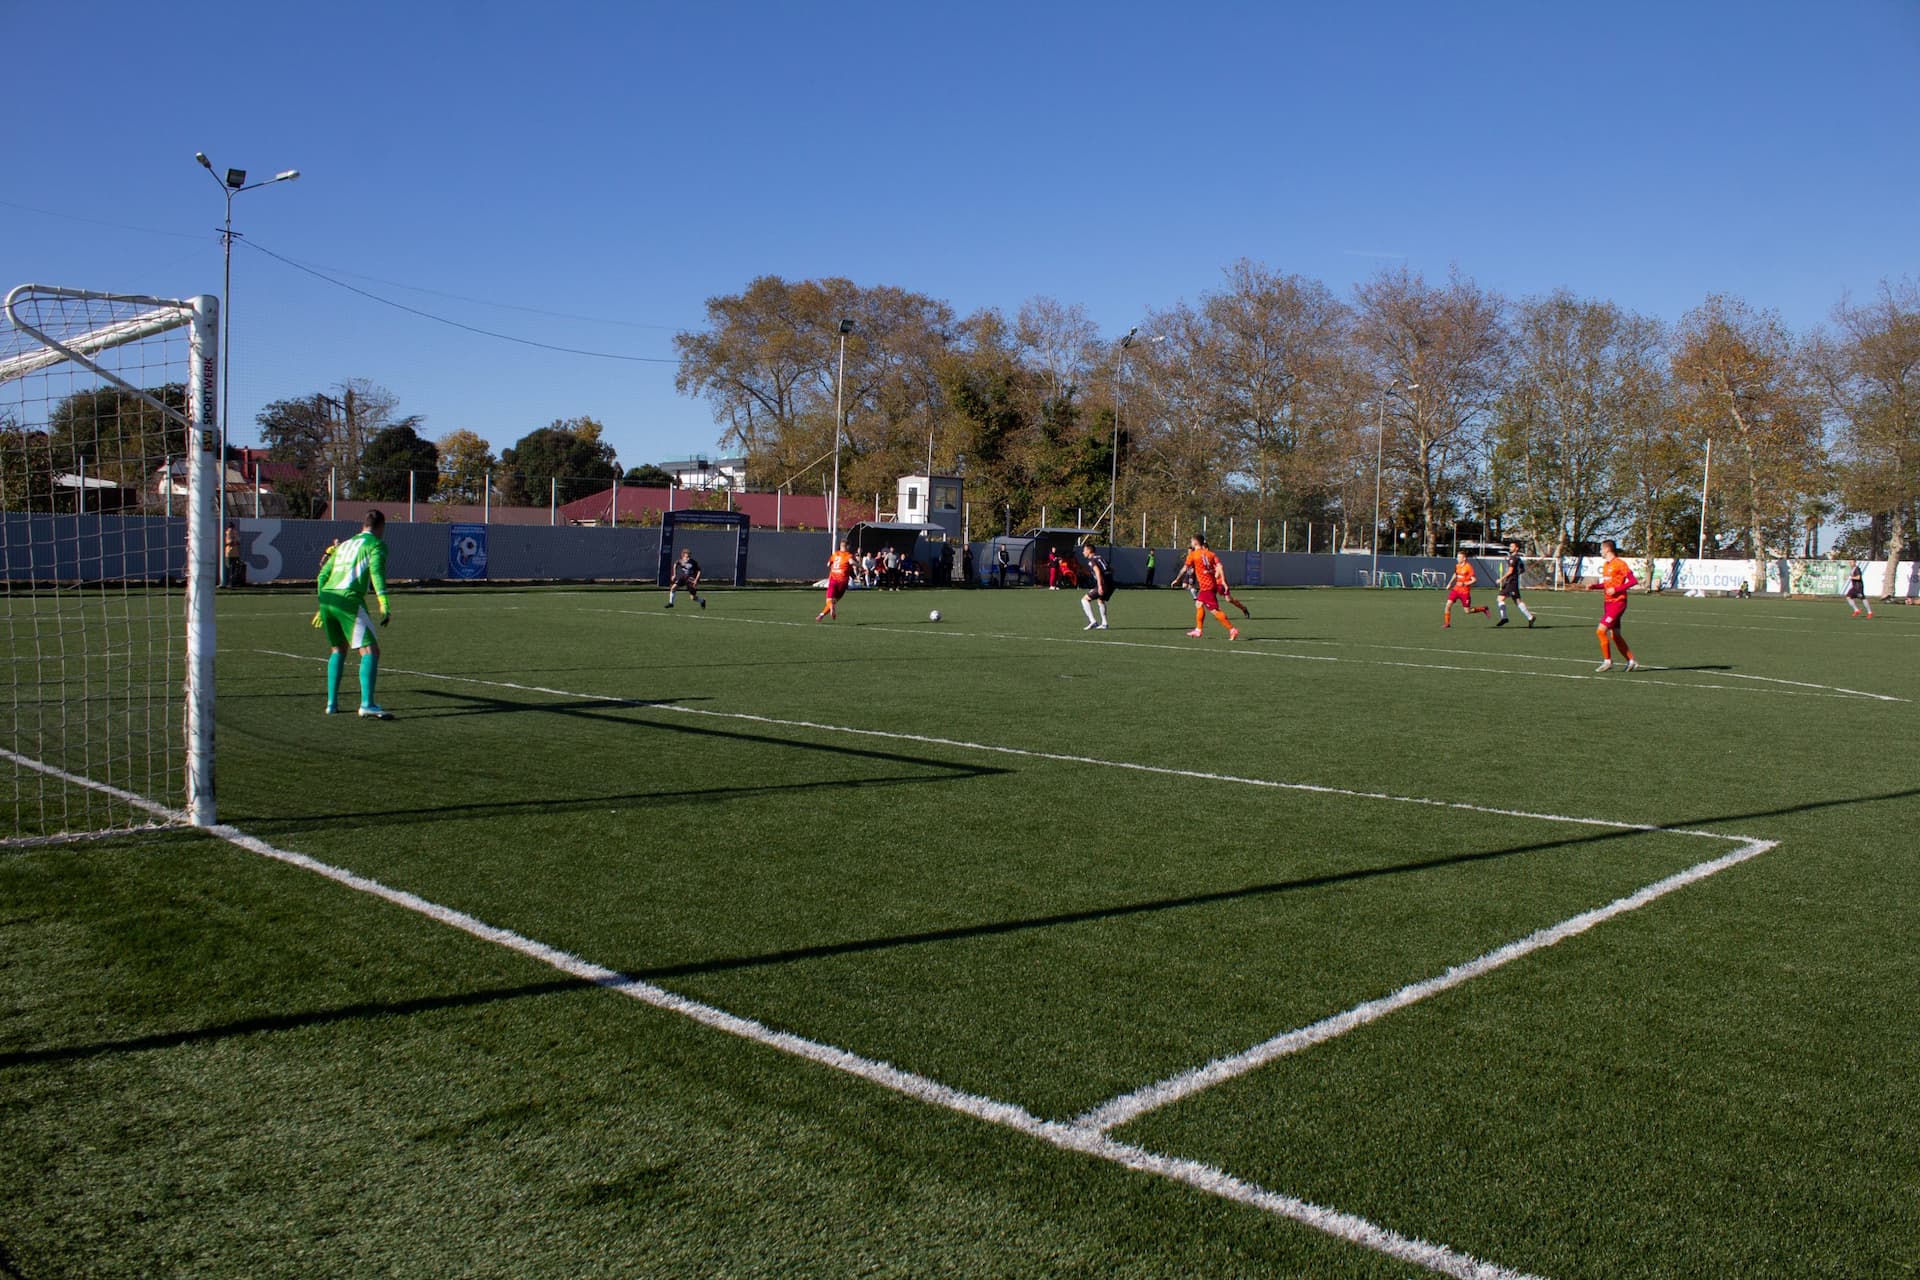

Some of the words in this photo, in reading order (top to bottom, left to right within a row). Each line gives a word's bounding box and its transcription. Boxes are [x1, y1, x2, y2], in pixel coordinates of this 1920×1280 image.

[203, 357, 213, 425] SPORTWERK
[240, 519, 282, 583] 3
[335, 537, 366, 562] 98
